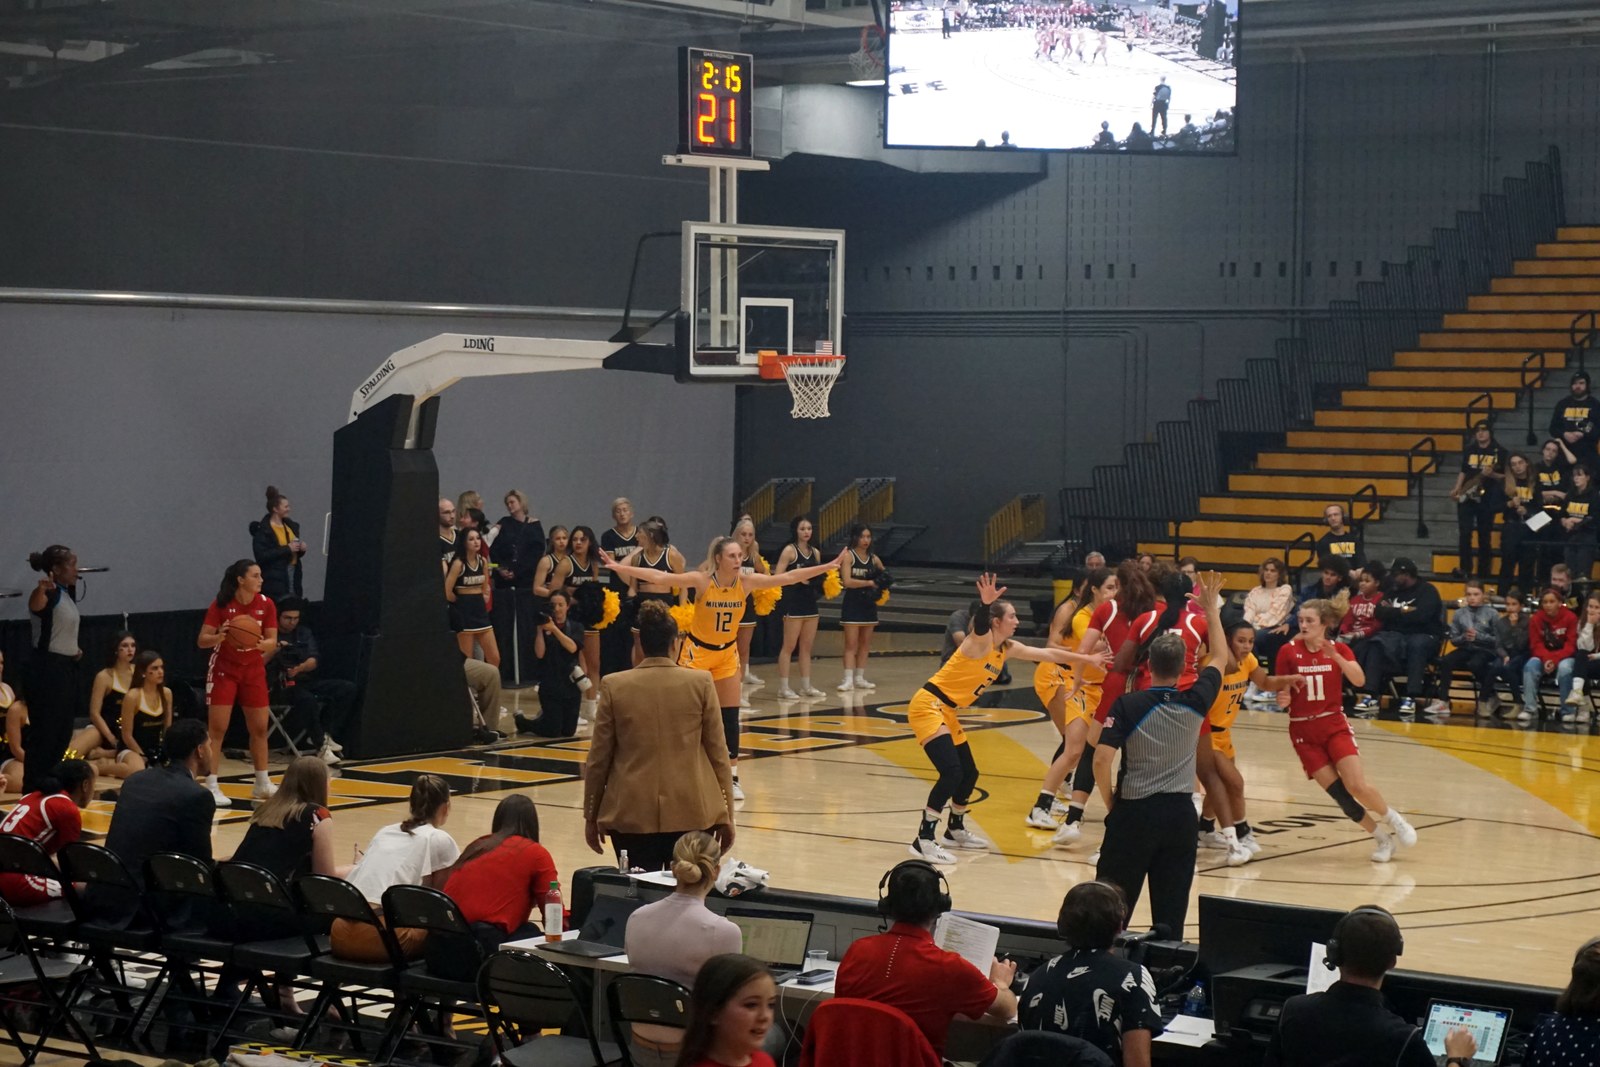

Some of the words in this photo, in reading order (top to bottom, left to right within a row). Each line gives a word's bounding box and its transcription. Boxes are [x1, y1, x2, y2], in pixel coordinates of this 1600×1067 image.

[702, 62, 741, 93] 2:15
[696, 92, 736, 144] 21
[358, 359, 396, 399] SPALDING
[715, 612, 733, 633] 12
[1297, 663, 1333, 674] WISCONSIN
[1305, 675, 1326, 702] 11
